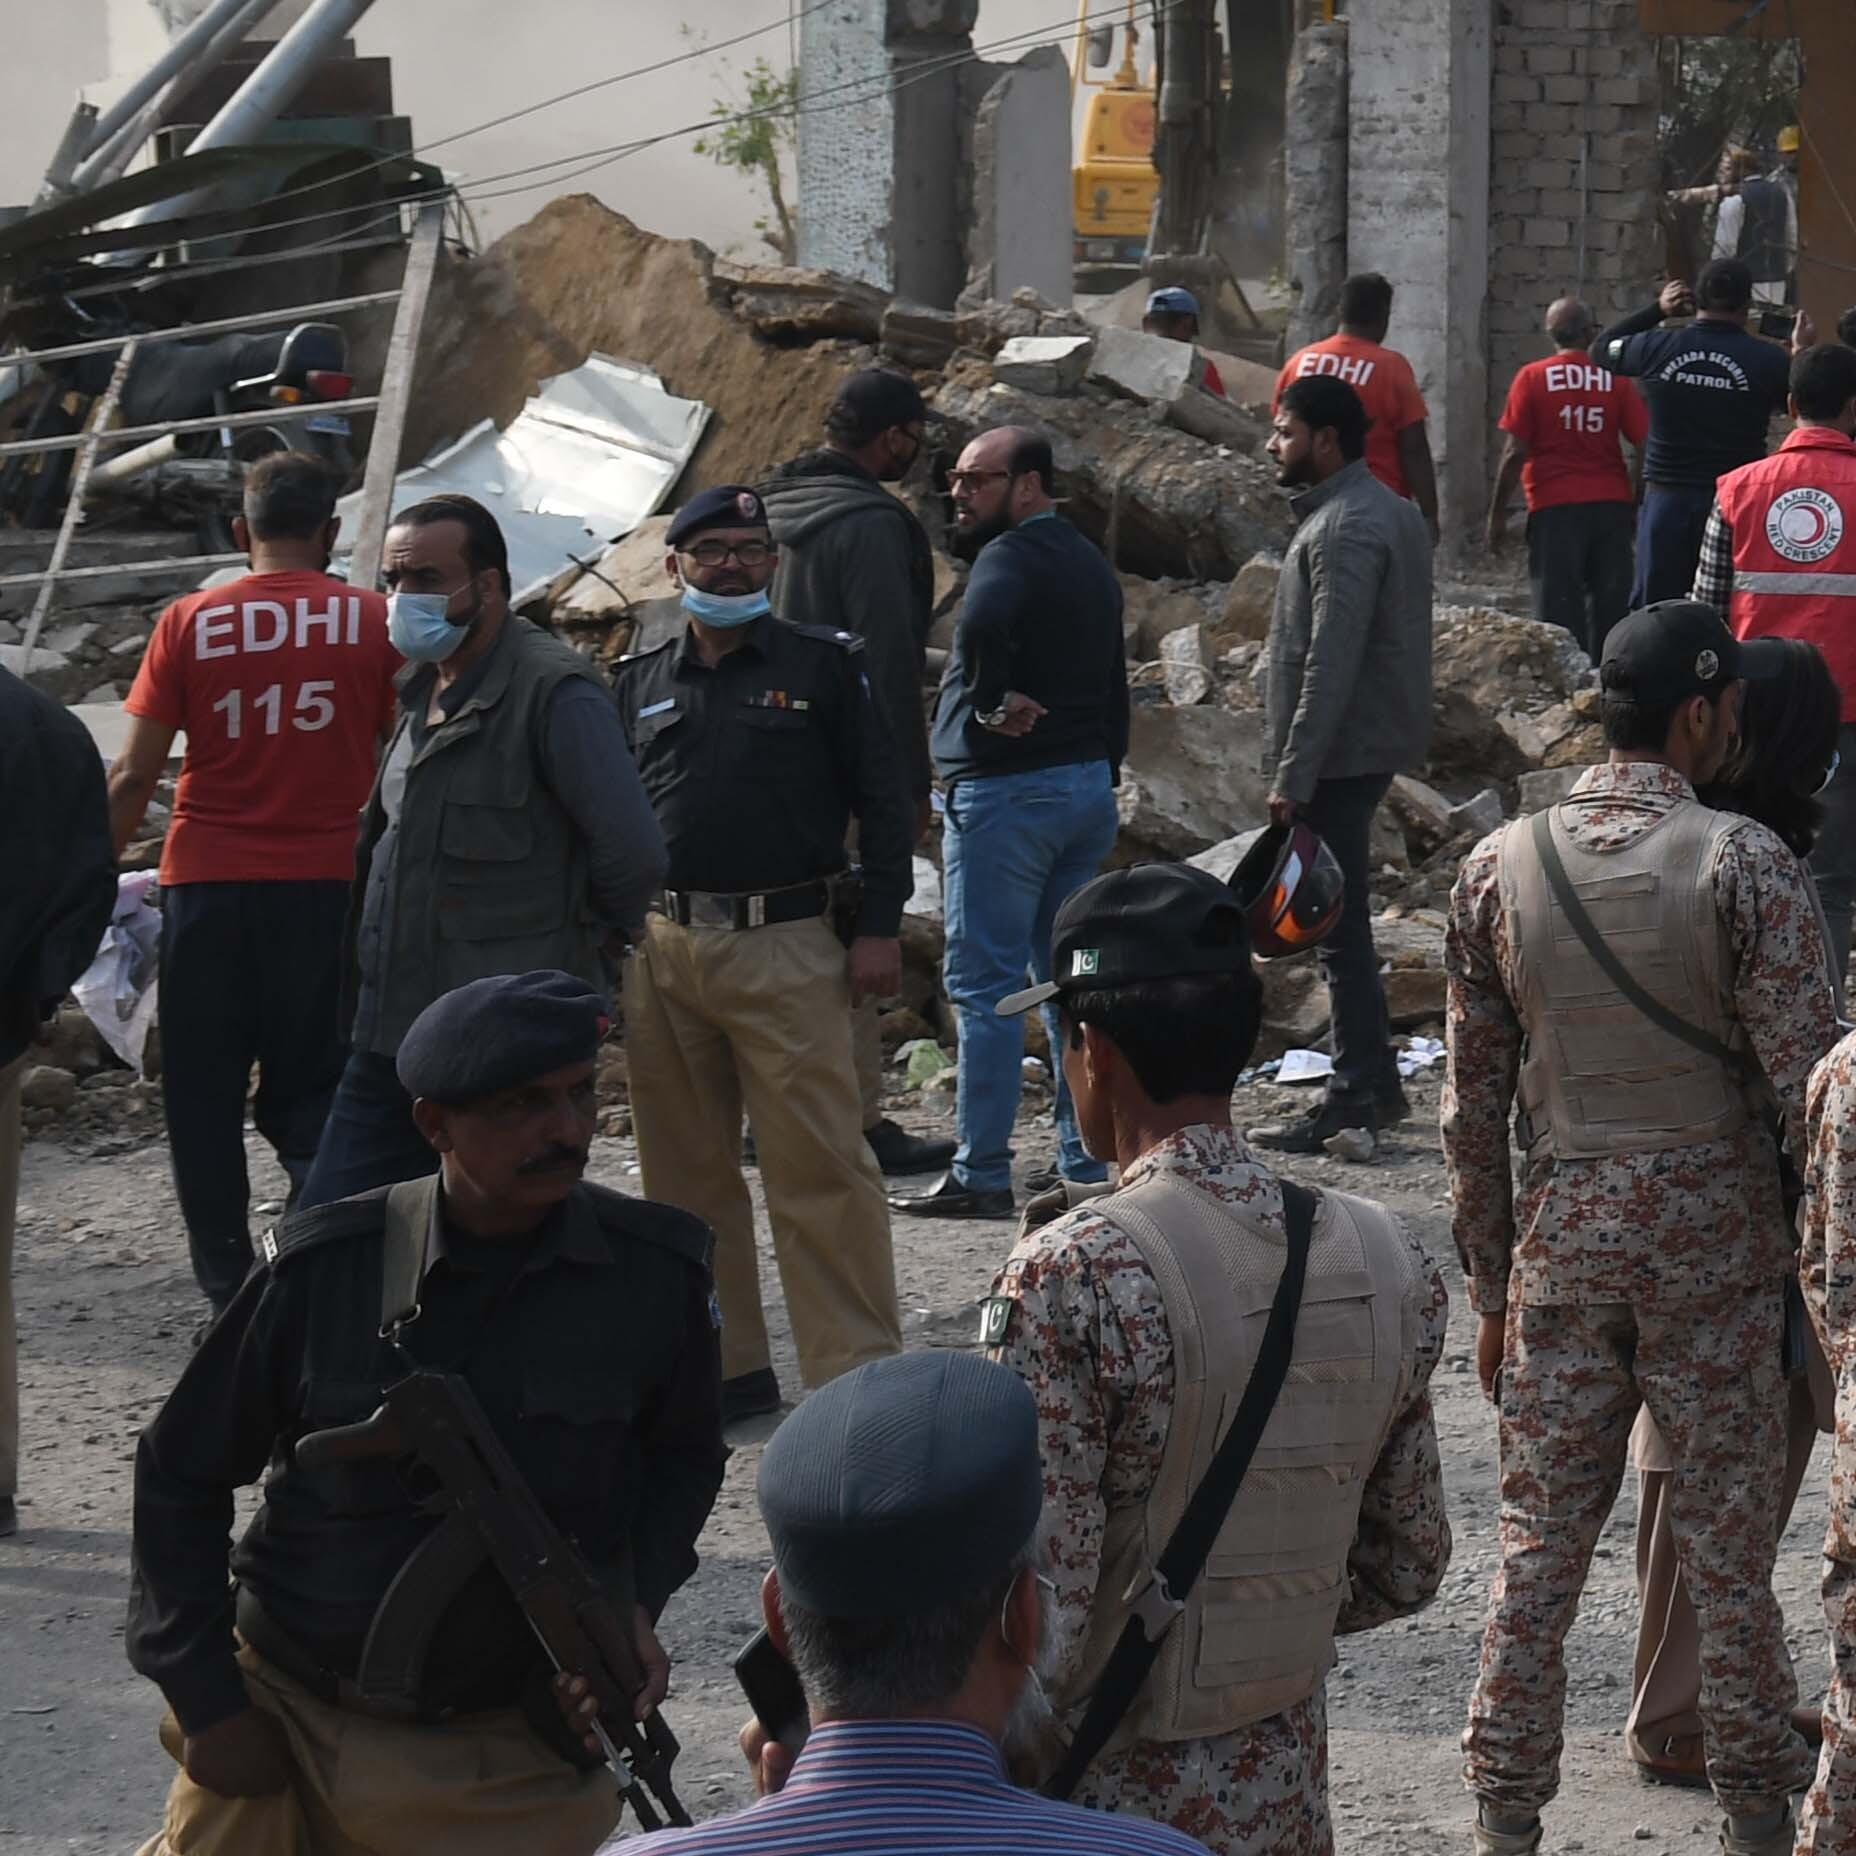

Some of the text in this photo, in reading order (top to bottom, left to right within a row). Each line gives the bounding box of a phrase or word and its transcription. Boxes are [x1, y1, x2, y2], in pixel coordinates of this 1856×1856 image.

[1546, 364, 1612, 392] EDHI
[1676, 371, 1734, 391] PATROL
[1560, 405, 1604, 433] 115
[1775, 490, 1835, 512] PAKISTAN
[1783, 528, 1842, 560] CRESCENT
[195, 596, 361, 660] EDHI
[214, 681, 337, 740] 115
